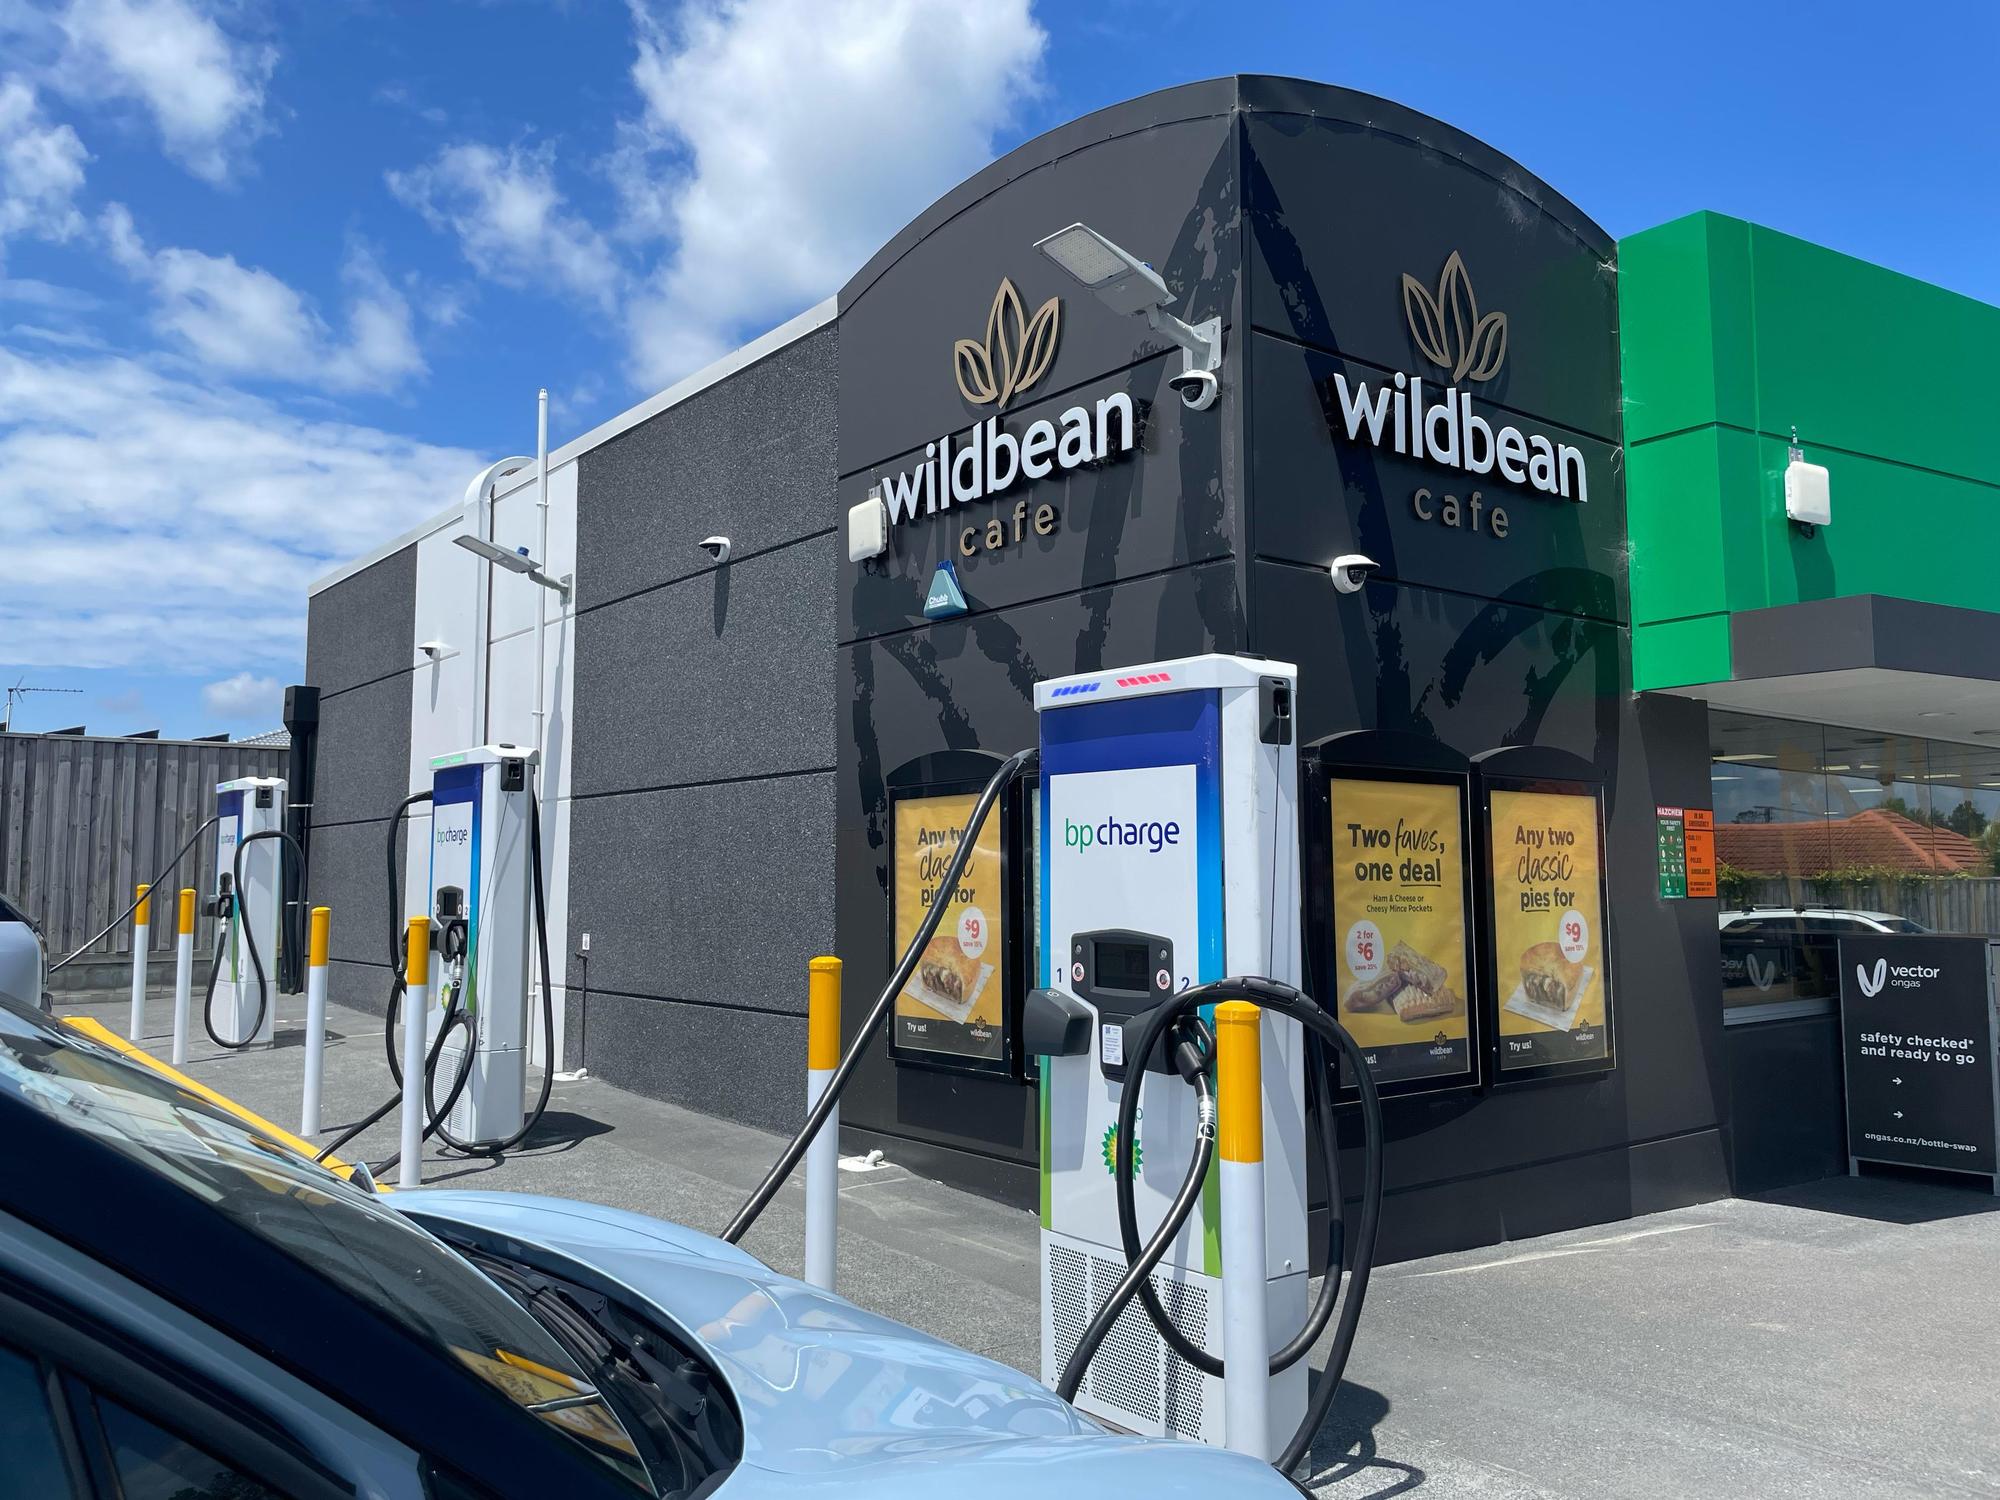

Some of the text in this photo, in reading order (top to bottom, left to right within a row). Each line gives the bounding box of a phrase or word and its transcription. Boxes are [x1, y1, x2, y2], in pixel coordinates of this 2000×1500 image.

[1333, 371, 1588, 502] wildbean
[882, 392, 1133, 525] wildbean
[1414, 488, 1509, 538] cafe
[960, 501, 1054, 557] cafe
[918, 827, 966, 848] Any tw
[1347, 818, 1445, 857] Two faves,
[1515, 825, 1575, 849] Any two
[1354, 858, 1442, 882] one deal
[1517, 847, 1574, 884] classic
[1520, 887, 1575, 911] pies for
[1366, 905, 1387, 914] Cheesy
[965, 919, 980, 939] $9
[1356, 930, 1374, 939] 2 for
[1565, 922, 1581, 942] $9
[1357, 942, 1374, 961] $6
[1056, 967, 1062, 983] 1
[1890, 965, 1940, 979] vector
[1181, 977, 1190, 991] 2
[1891, 979, 1921, 989] ongas
[907, 1022, 927, 1033] Try us!
[1509, 1040, 1532, 1052] Try us!
[1860, 1032, 1902, 1046] safety
[1861, 1045, 1976, 1065] and ready to go
[1864, 1132, 1977, 1152] ongas.co.nz/bottle-swap
